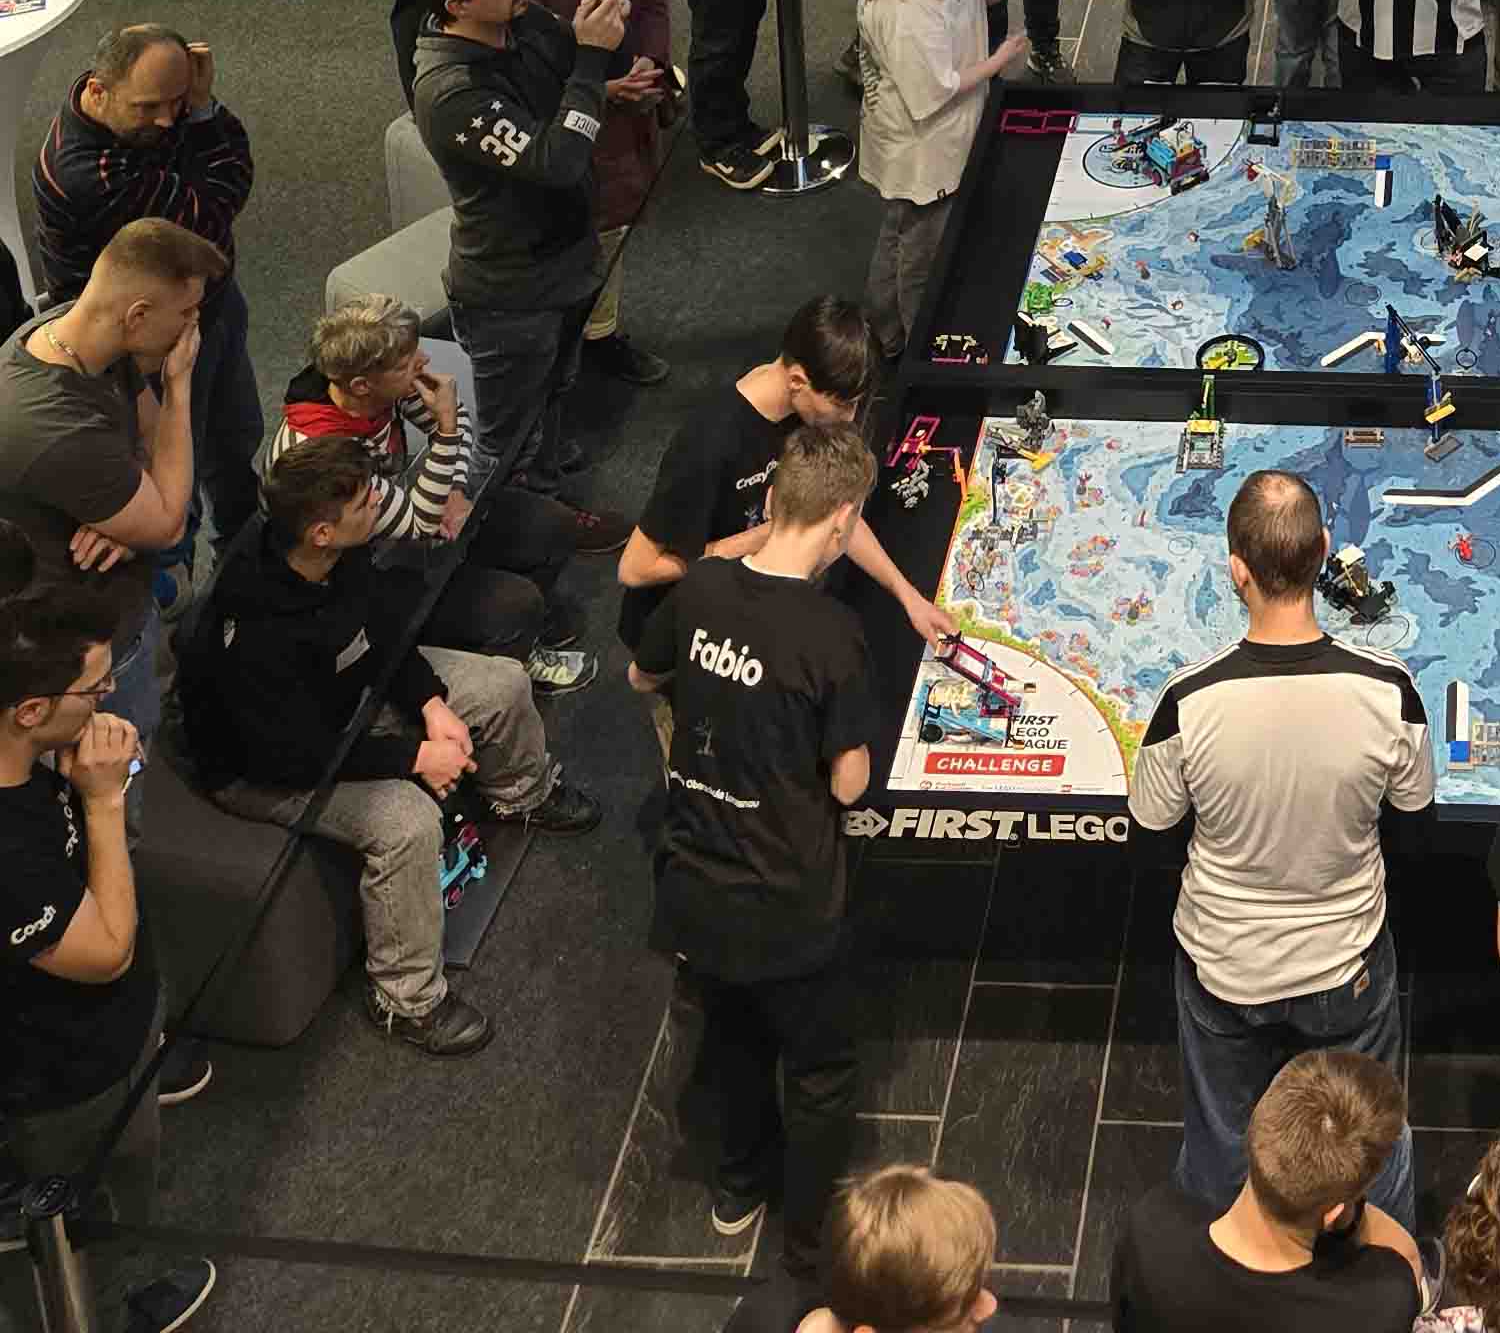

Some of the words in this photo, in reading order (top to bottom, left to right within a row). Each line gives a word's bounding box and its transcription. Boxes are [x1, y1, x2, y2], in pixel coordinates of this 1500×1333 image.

[480, 118, 531, 166] 32
[689, 628, 763, 686] Fabio
[1010, 714, 1057, 726] FIRST
[1014, 727, 1049, 738] EGO
[1004, 739, 1068, 750] LAGUE
[936, 757, 1053, 773] CHALLENGE
[889, 808, 1025, 840] FIRST
[1027, 813, 1129, 843] LEGO
